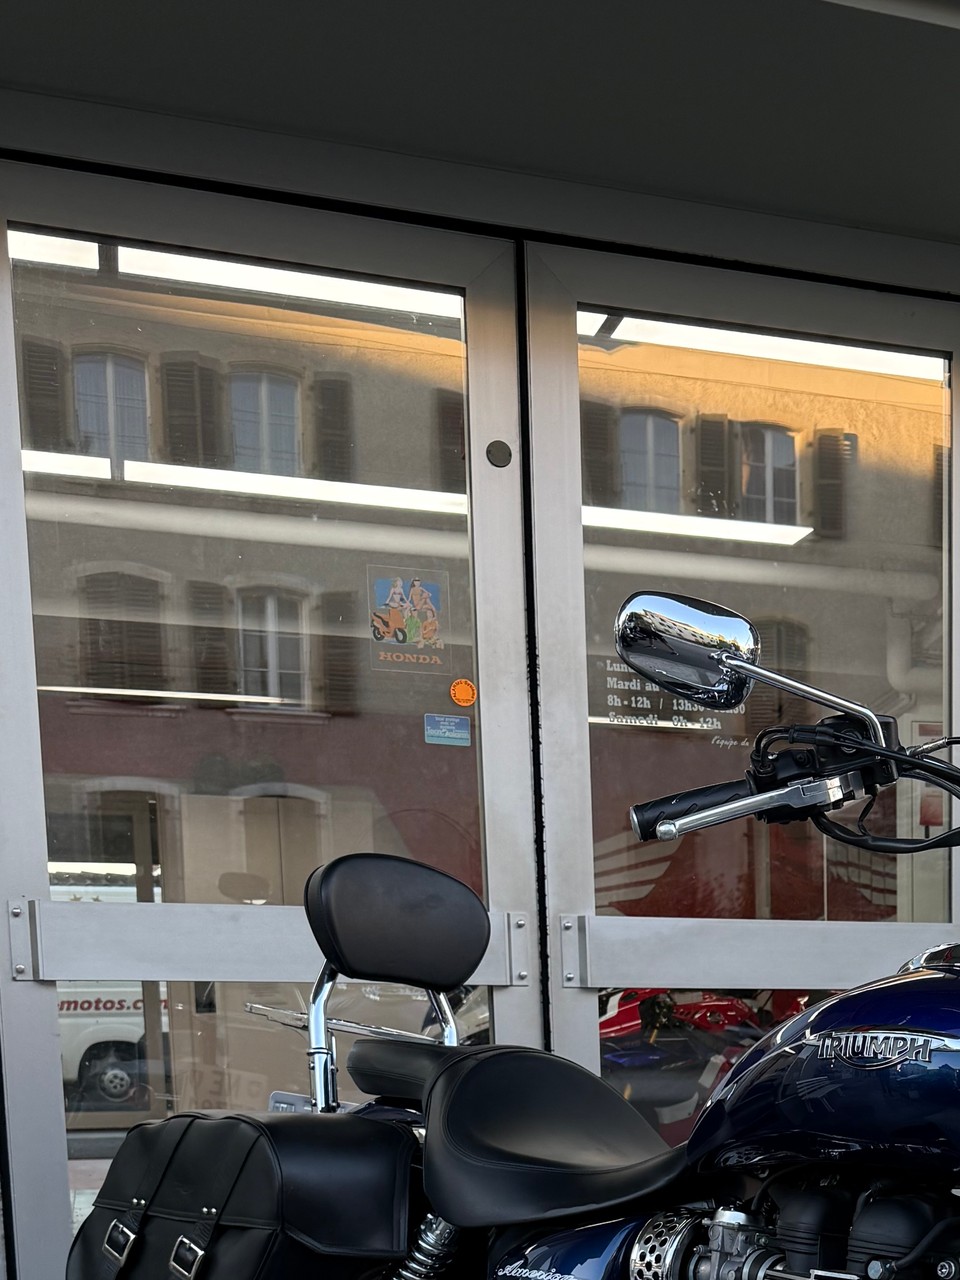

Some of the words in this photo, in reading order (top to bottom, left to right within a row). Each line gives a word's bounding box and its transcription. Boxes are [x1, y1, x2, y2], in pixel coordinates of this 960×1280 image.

[378, 651, 443, 665] HONDA
[606, 660, 638, 672] Lun
[606, 677, 641, 690] Mardi
[645, 682, 660, 692] au
[608, 712, 658, 726] Samedi
[817, 1032, 932, 1067] TRIUMPH
